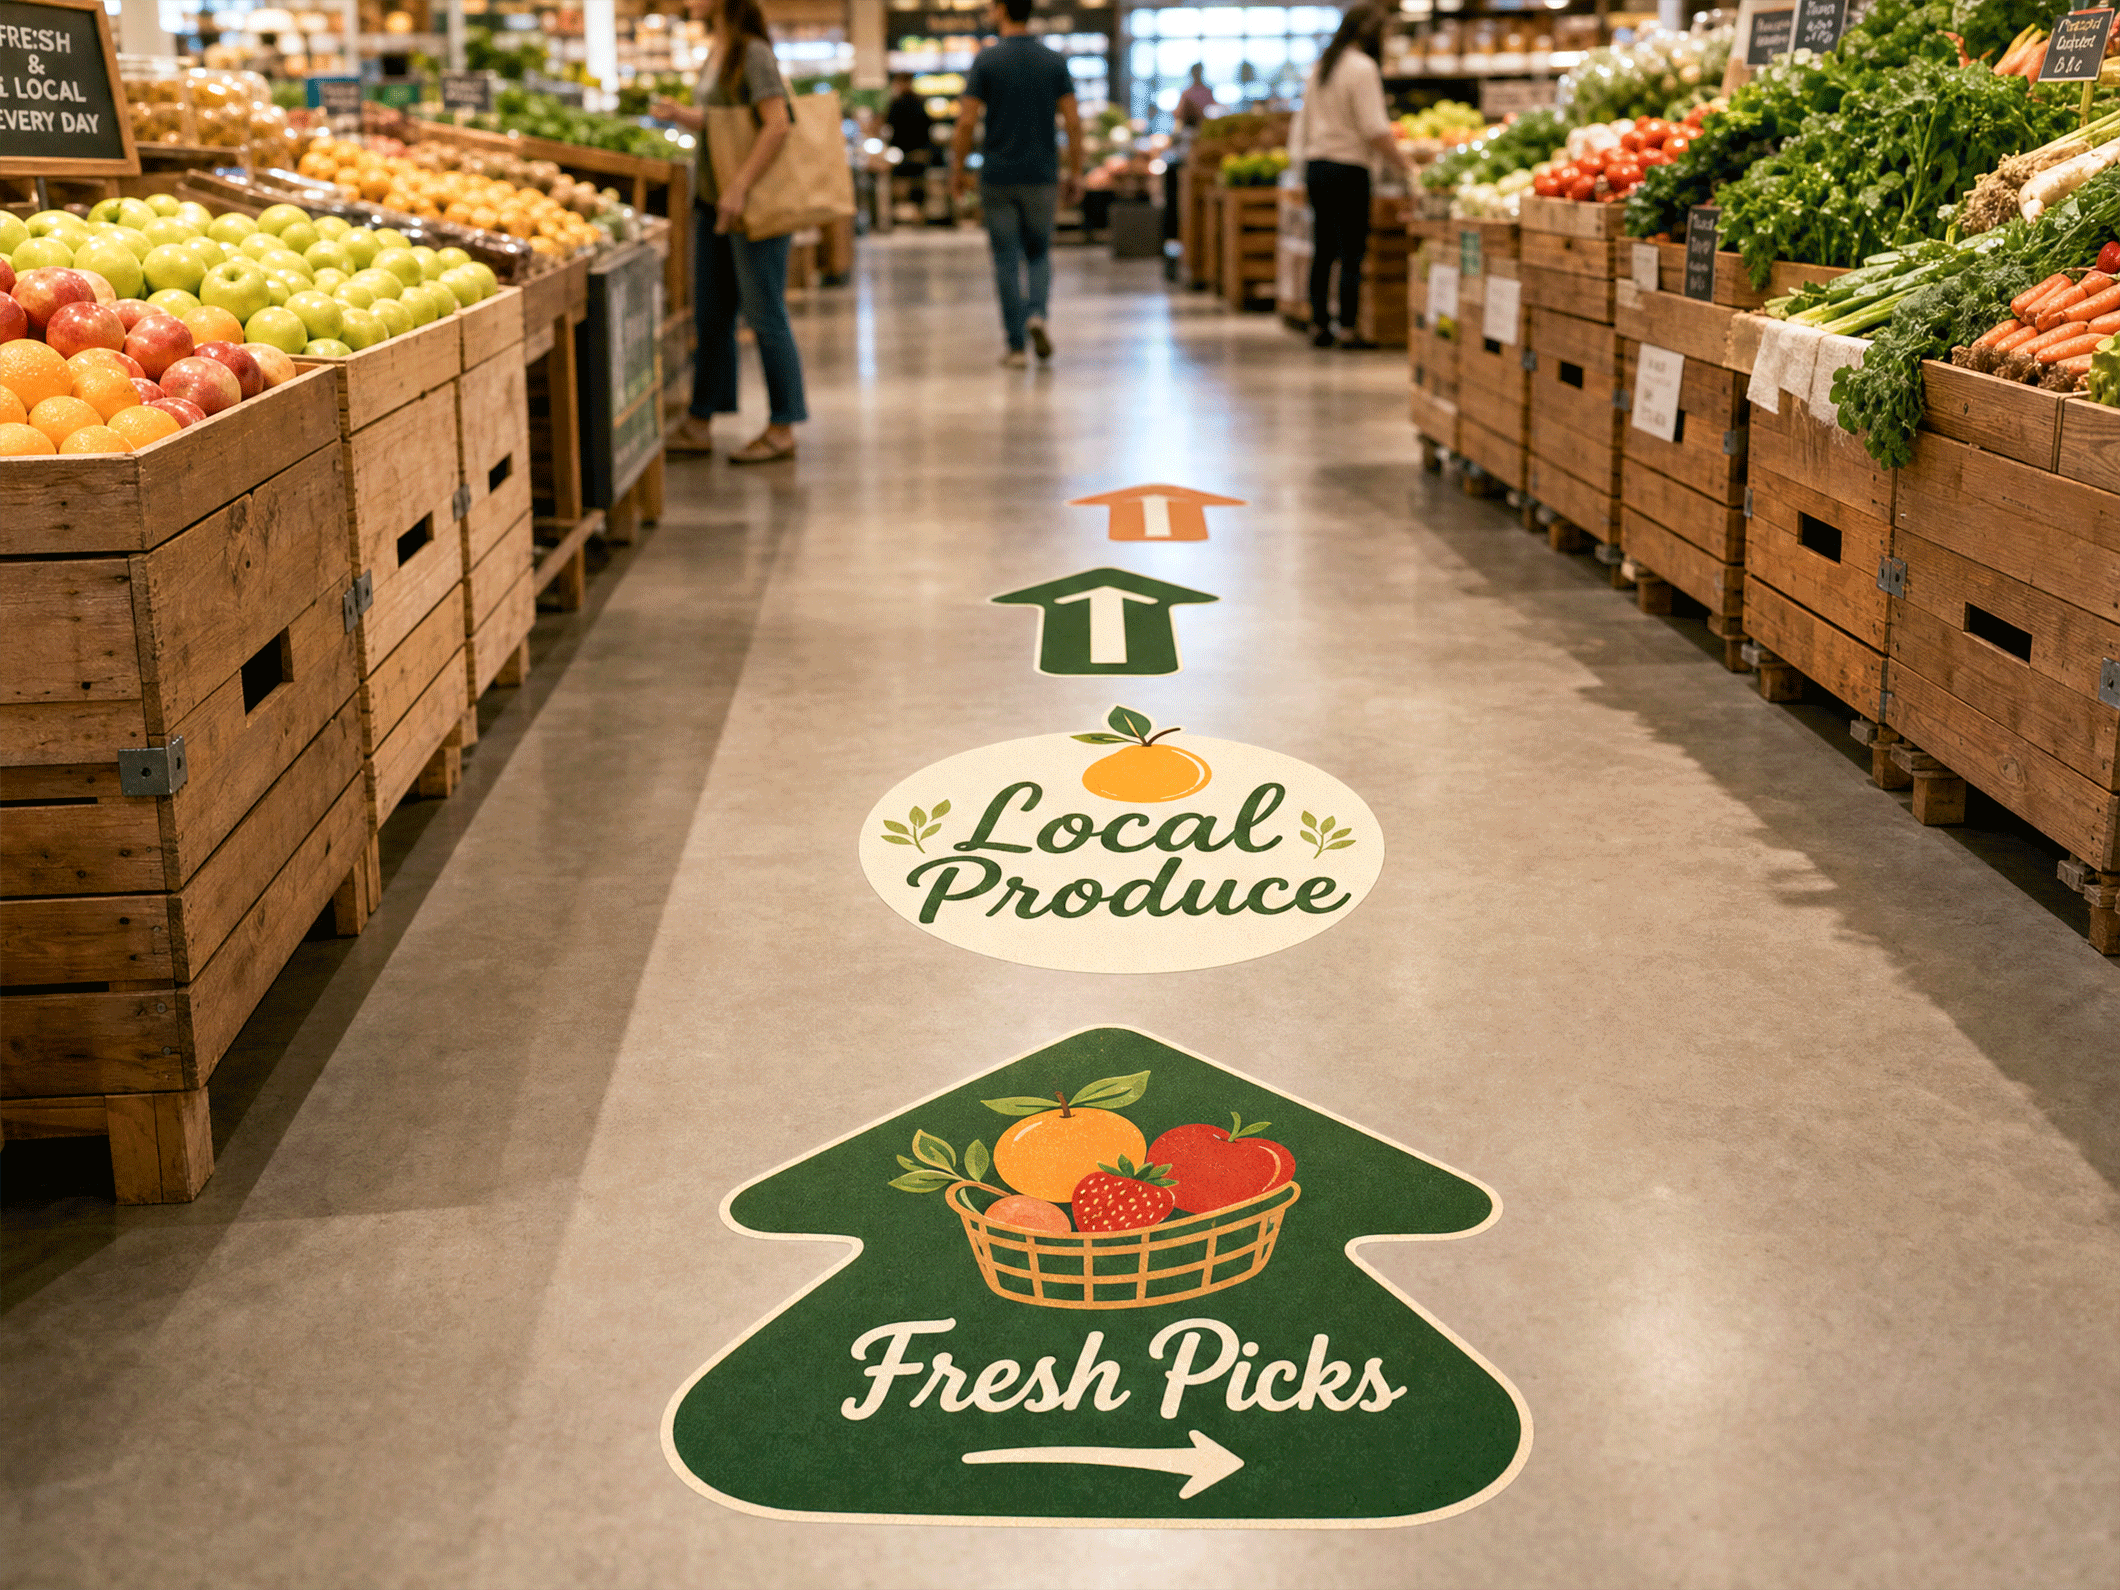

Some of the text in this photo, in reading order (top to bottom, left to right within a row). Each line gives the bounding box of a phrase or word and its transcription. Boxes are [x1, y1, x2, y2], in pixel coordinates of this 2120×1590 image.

[27, 54, 45, 75] &
[14, 77, 87, 102] LOCAL
[60, 112, 99, 134] DAY
[952, 781, 1286, 854] Local
[906, 856, 1352, 925] Produce
[840, 1317, 1408, 1421] Fresh Picks
